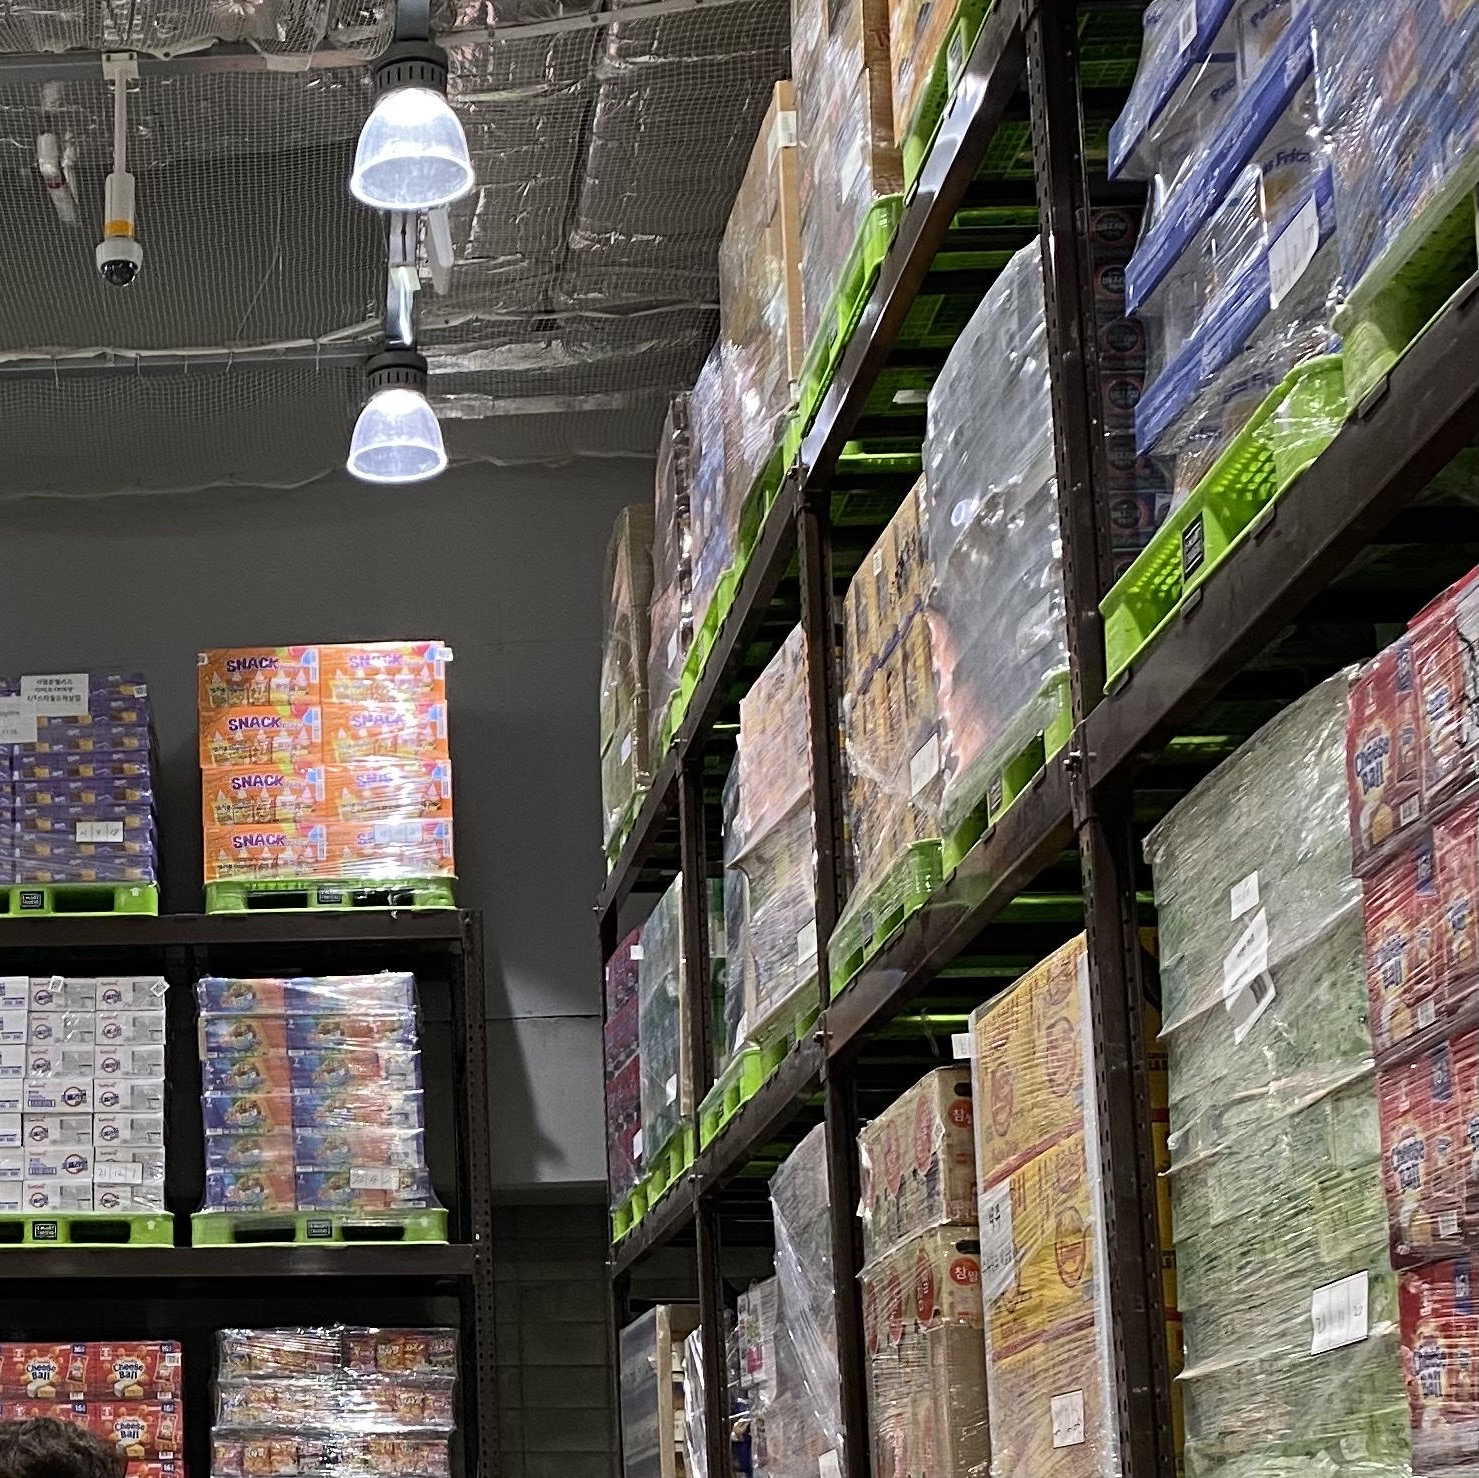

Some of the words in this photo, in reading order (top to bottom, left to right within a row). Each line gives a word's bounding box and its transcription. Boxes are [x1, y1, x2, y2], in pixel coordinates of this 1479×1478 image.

[226, 653, 279, 673] SNACK
[228, 716, 282, 732] SNACK
[231, 774, 284, 790] SNACK
[232, 833, 286, 849] SNACK
[26, 1364, 57, 1374] Cheese
[113, 1363, 144, 1373] Cheese
[32, 1370, 51, 1381] Ball
[119, 1369, 138, 1379] Ball
[114, 1423, 145, 1432] Cheese
[120, 1429, 139, 1439] Ball
